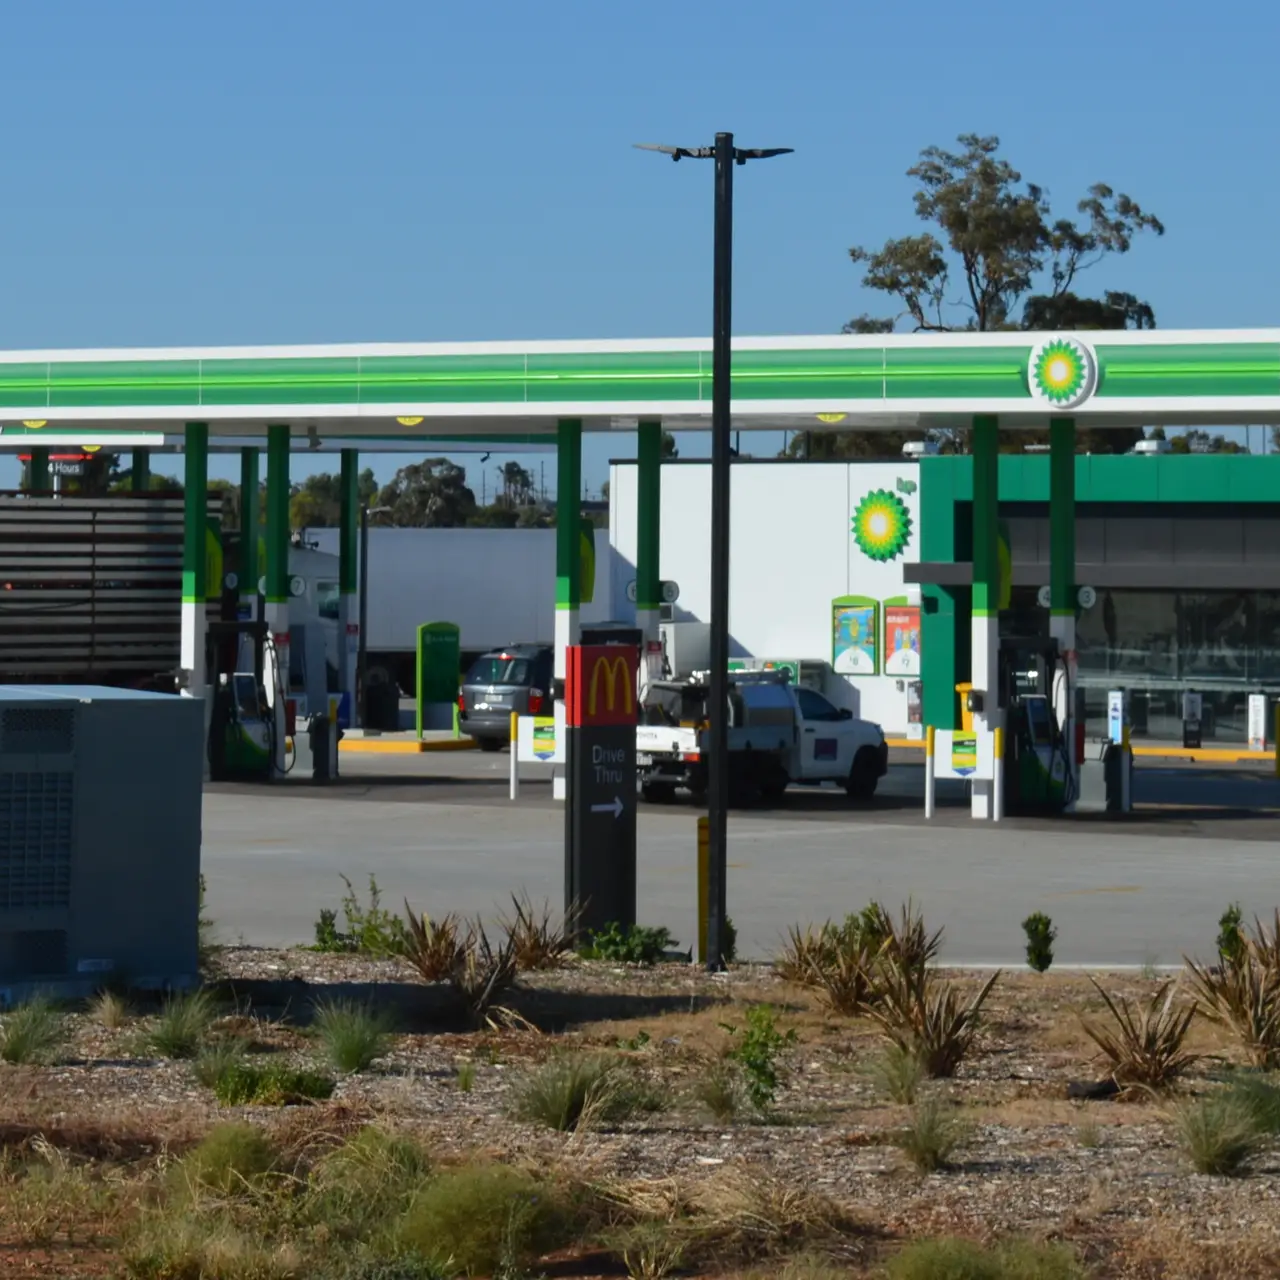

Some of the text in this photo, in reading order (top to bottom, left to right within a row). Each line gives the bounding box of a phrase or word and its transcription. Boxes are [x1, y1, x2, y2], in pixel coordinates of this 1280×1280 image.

[55, 462, 80, 473] Hours
[592, 745, 625, 764] Drive
[594, 766, 623, 784] Thru
